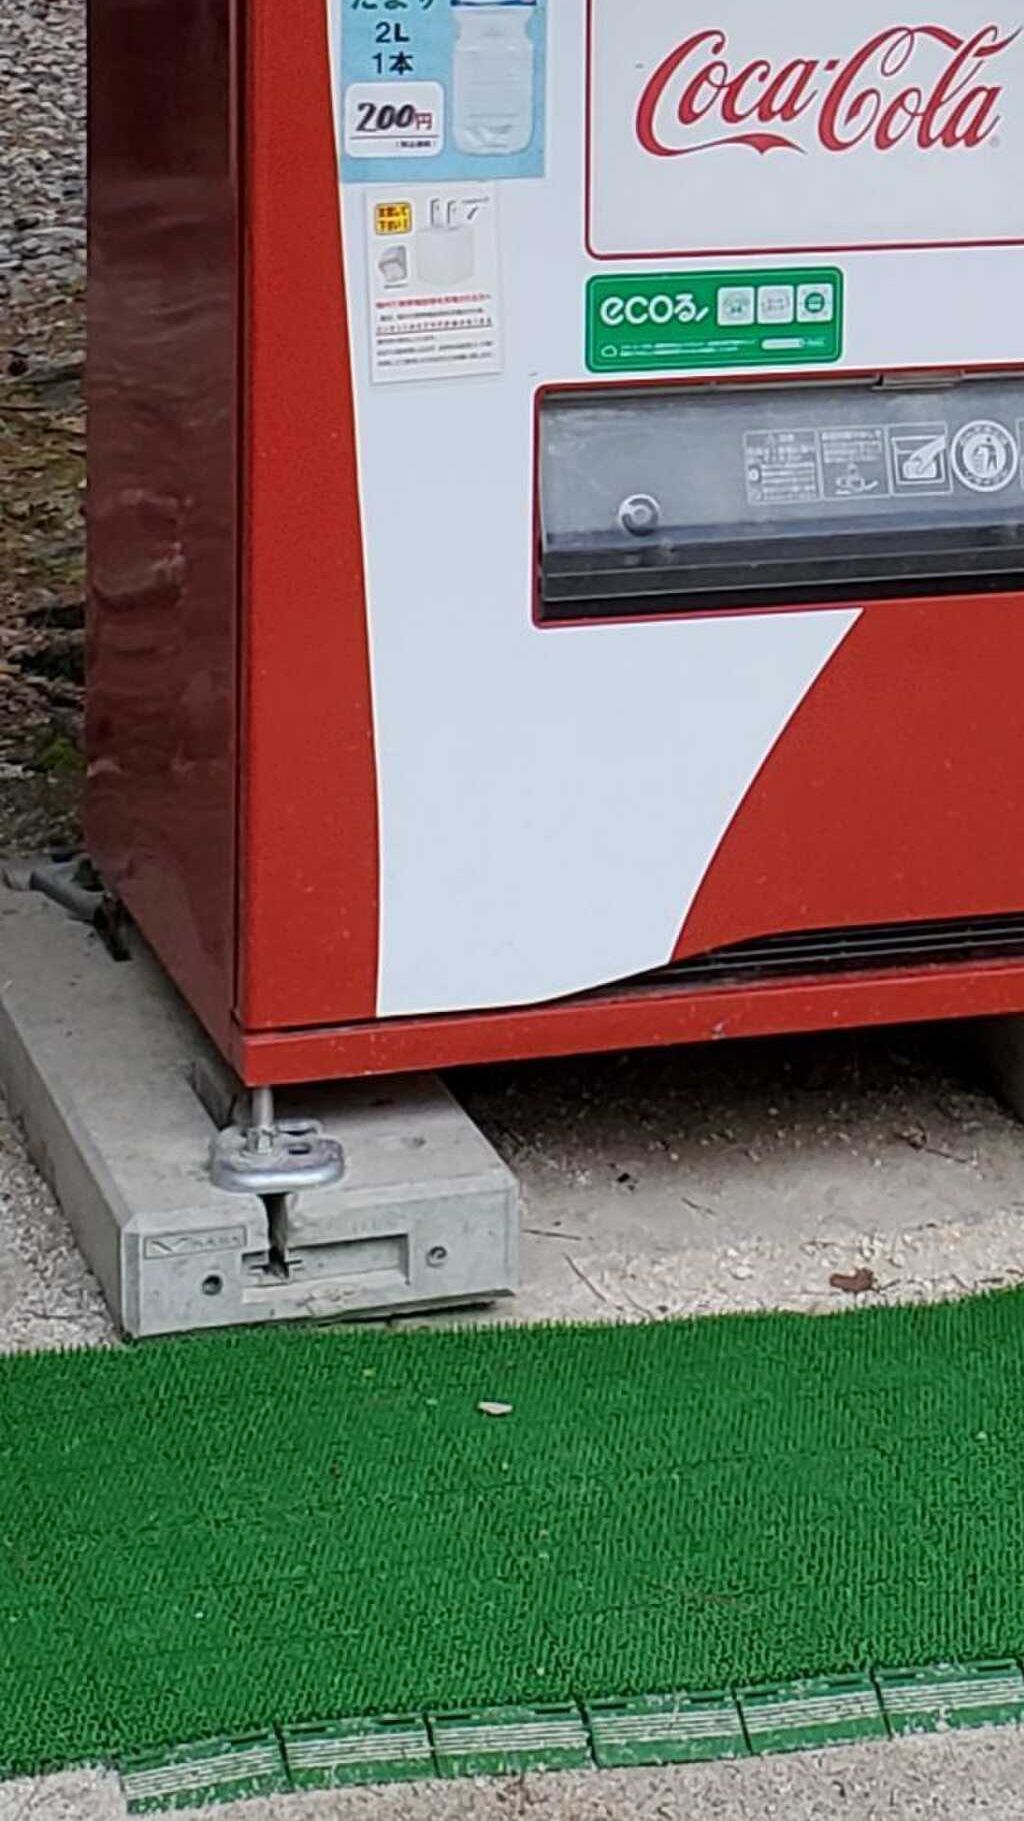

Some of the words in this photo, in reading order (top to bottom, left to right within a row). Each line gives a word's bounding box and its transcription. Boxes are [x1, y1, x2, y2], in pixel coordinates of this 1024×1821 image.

[375, 22, 410, 43] 2L
[372, 52, 413, 75] 1本
[356, 102, 433, 132] 200円
